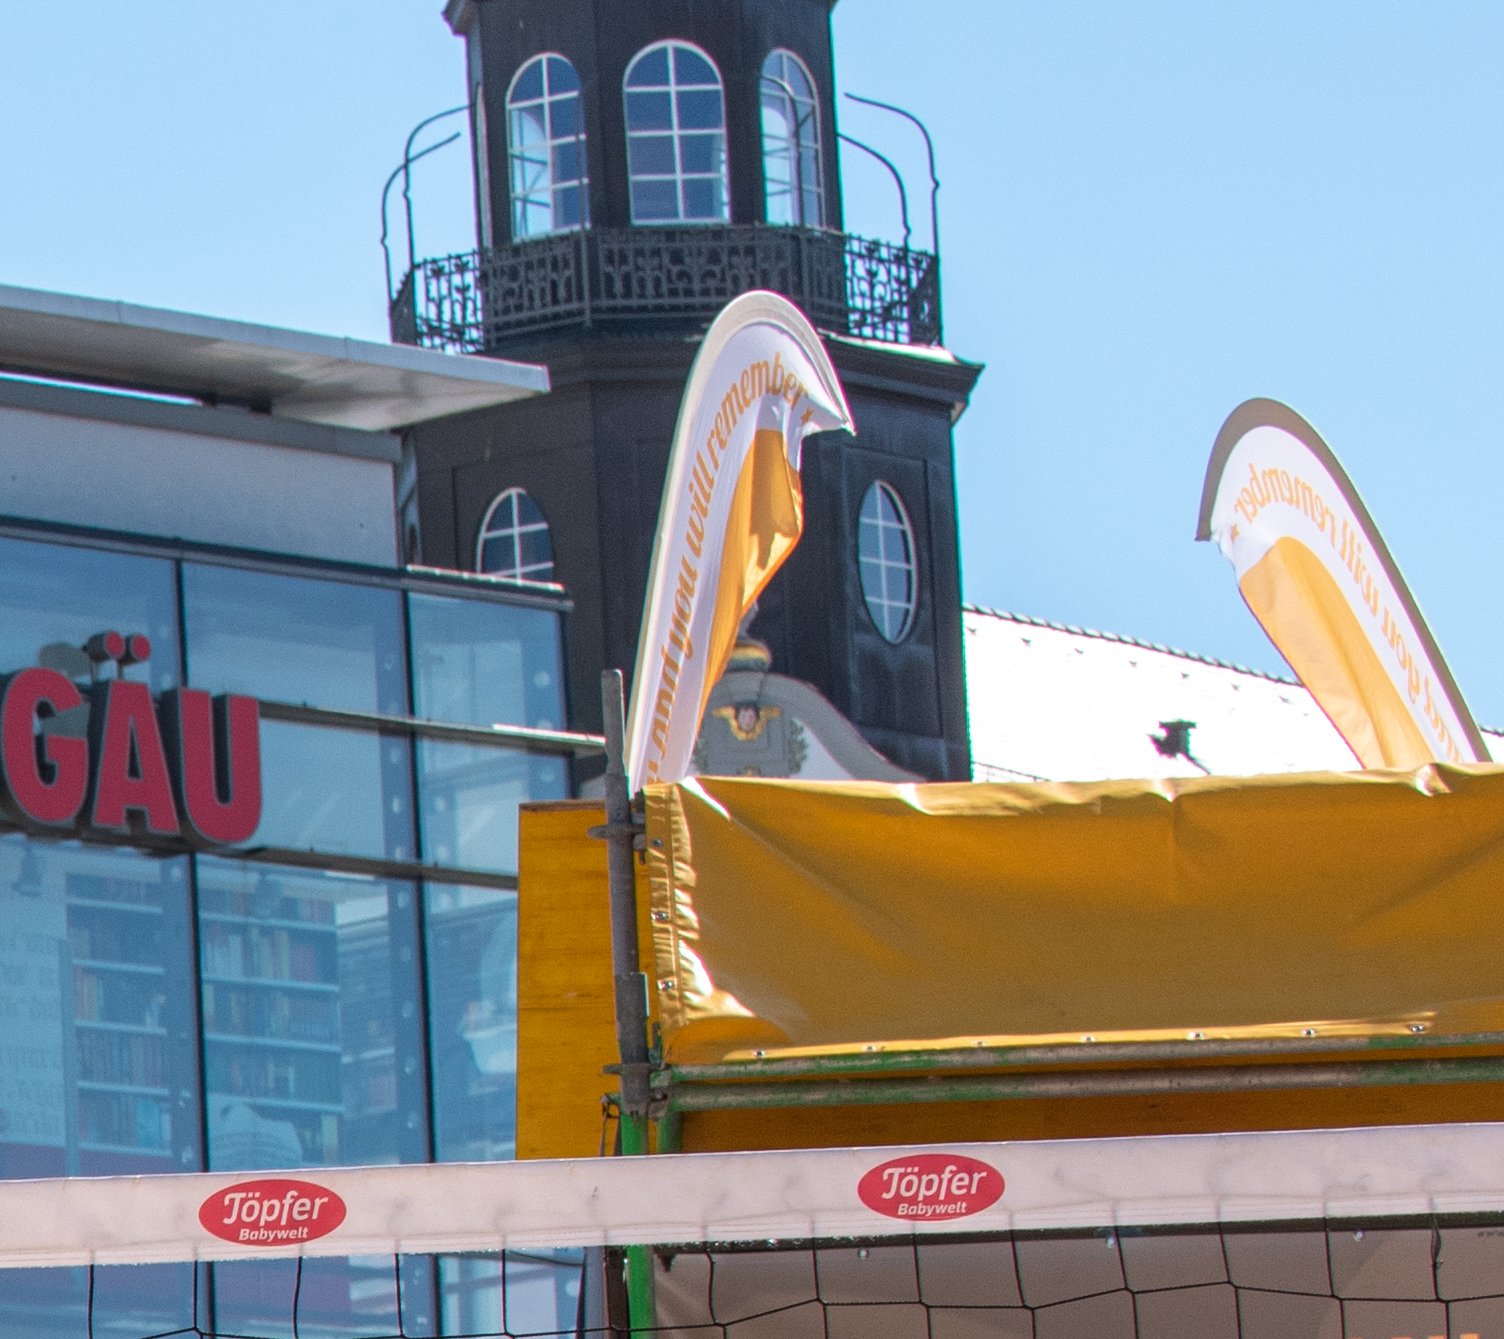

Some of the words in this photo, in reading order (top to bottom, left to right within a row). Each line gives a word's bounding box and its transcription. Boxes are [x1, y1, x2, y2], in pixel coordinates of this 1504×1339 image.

[661, 556, 698, 660] you
[685, 448, 718, 560] will
[706, 352, 811, 470] remember
[881, 1164, 987, 1202] Töpfer
[223, 1190, 328, 1227] Töpfer
[897, 1201, 966, 1216] Babywelt
[239, 1227, 308, 1241] Babywelt
